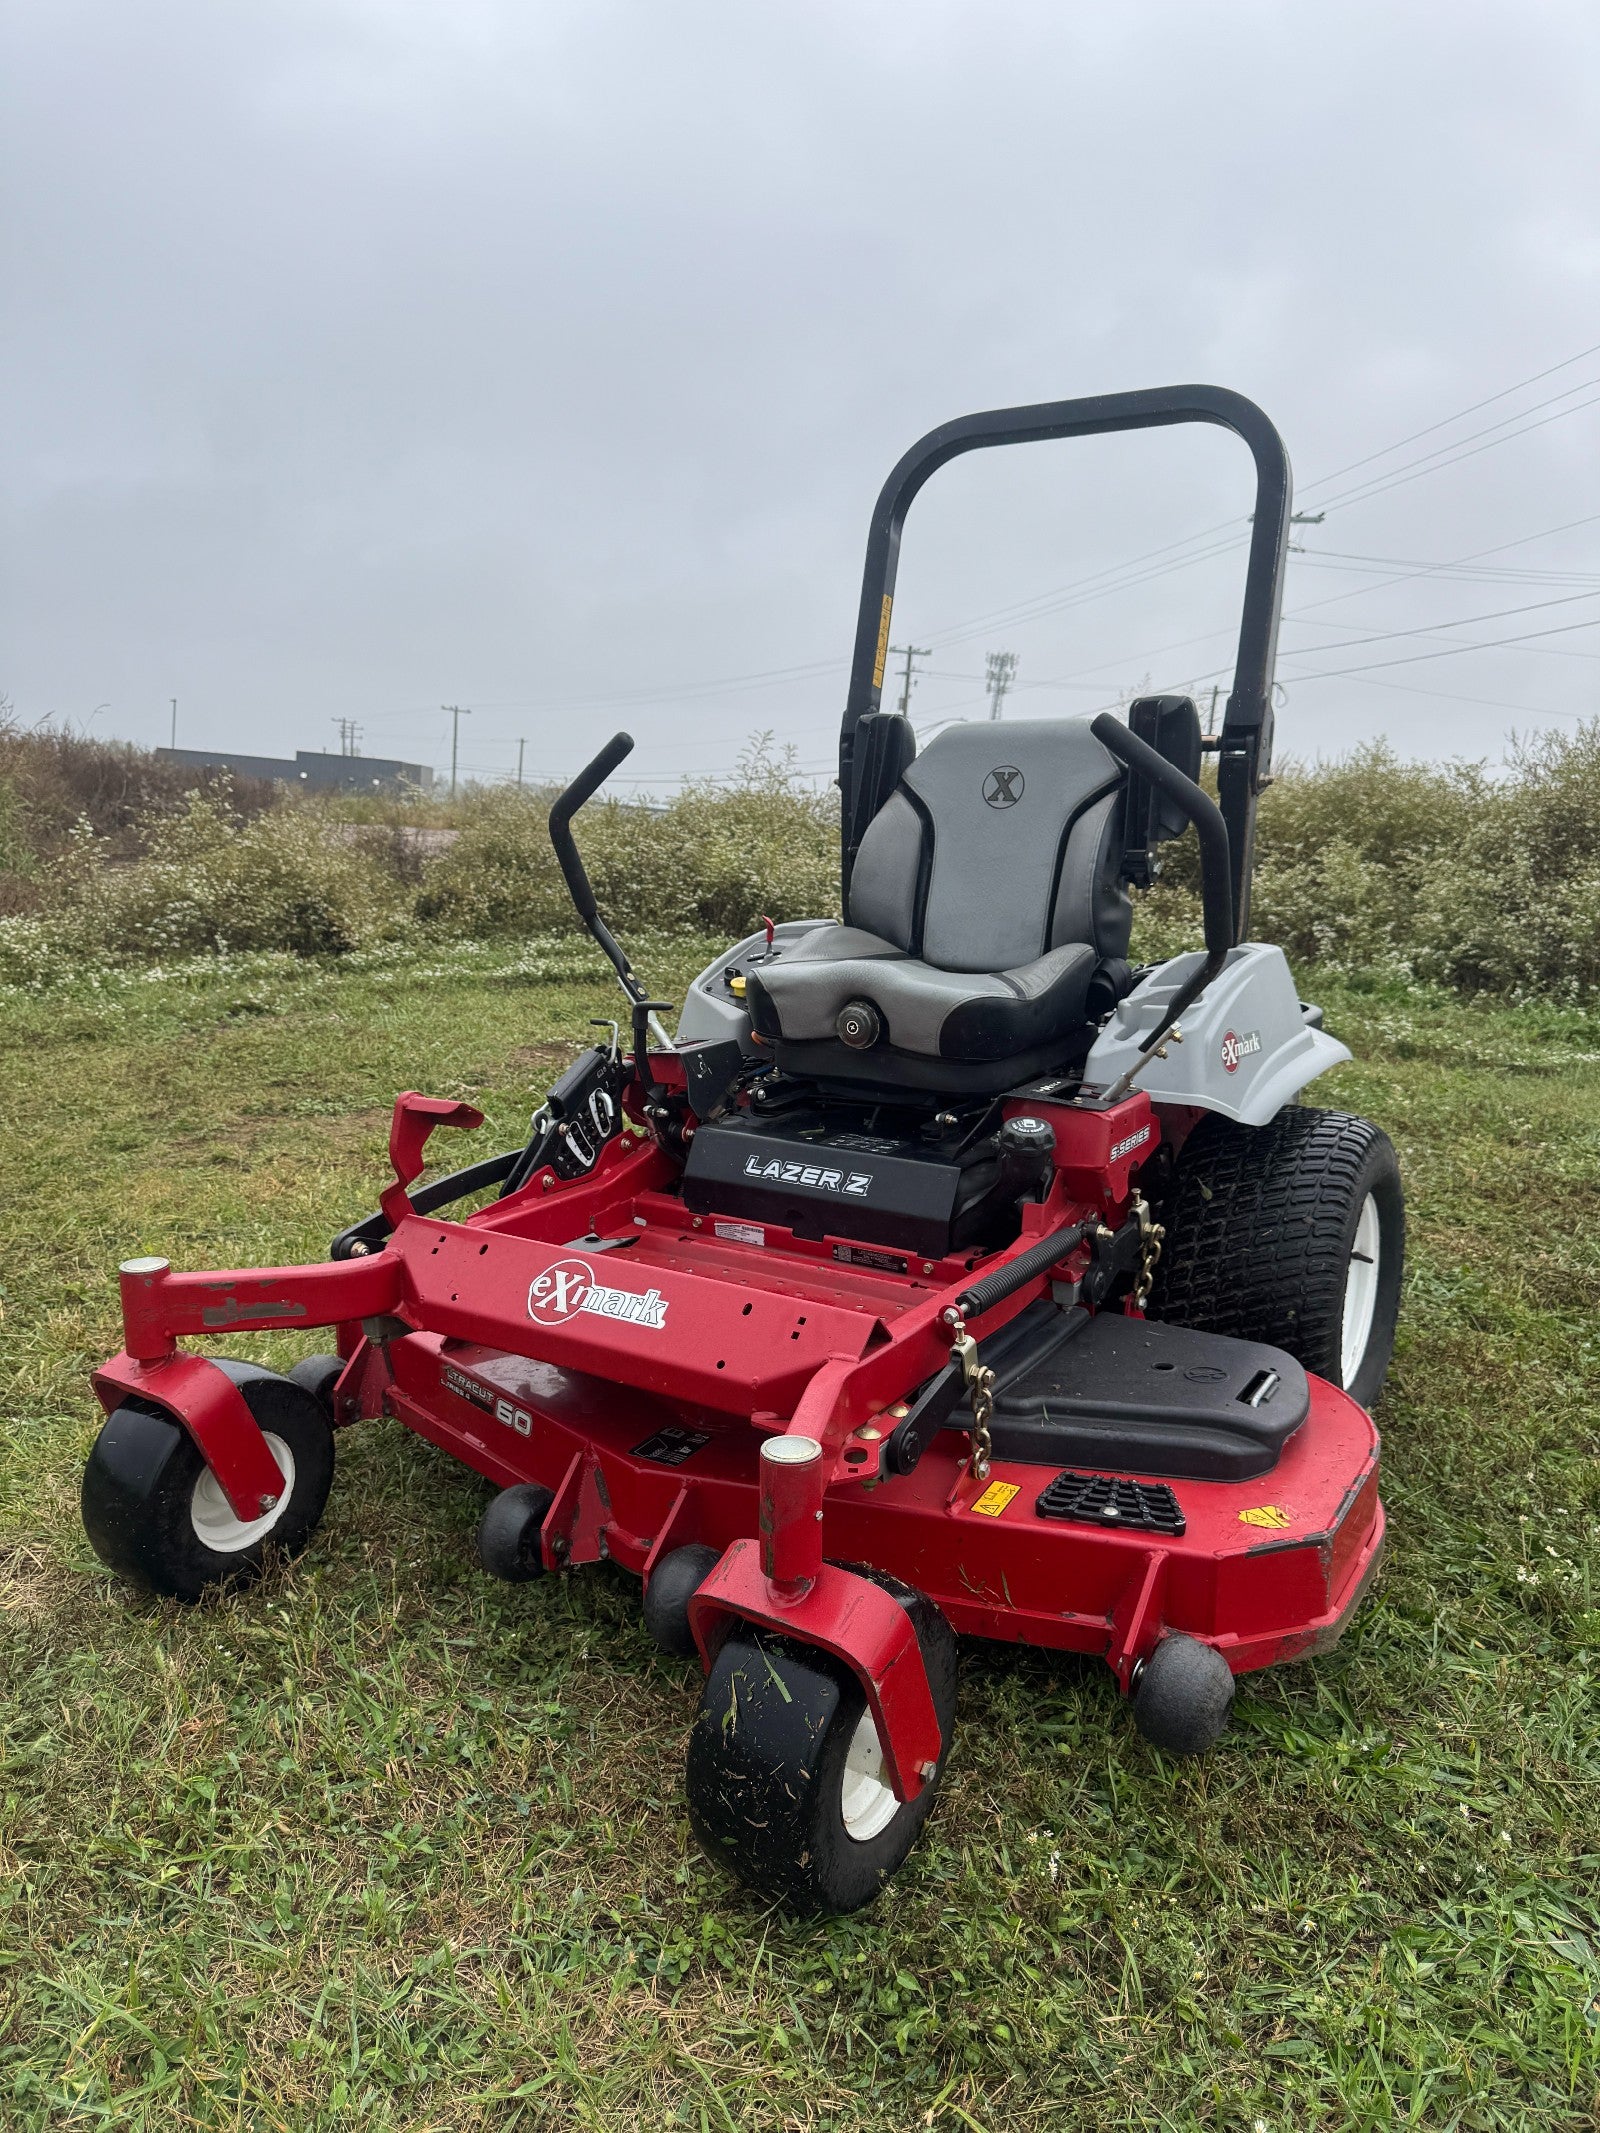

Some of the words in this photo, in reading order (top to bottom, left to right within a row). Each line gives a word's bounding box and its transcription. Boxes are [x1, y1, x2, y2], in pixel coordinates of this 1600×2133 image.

[987, 771, 1019, 802] X
[1221, 1033, 1261, 1066] eXmark
[744, 1156, 843, 1192] LAZER
[843, 1172, 874, 1196] Z
[530, 1266, 668, 1327] eXmark
[496, 1397, 533, 1438] 60
